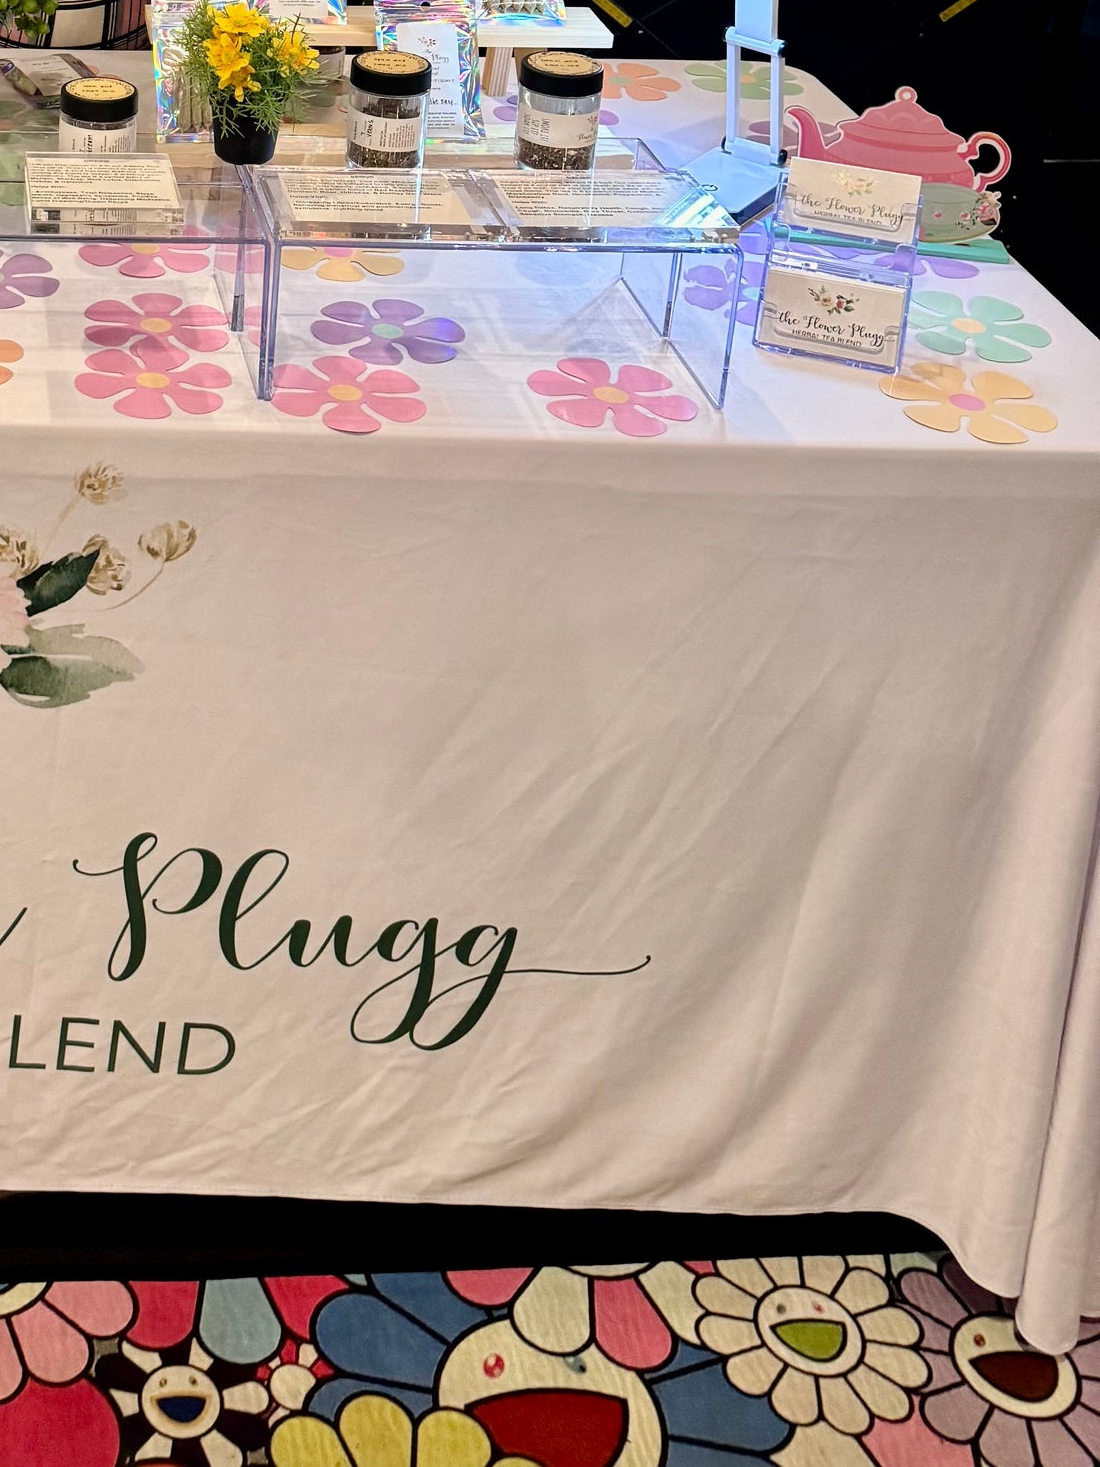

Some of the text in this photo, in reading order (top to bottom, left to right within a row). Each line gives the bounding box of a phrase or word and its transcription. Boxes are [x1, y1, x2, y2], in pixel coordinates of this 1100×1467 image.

[797, 192, 905, 225] the Flower Plugg
[777, 311, 885, 347] the Flower Plugg
[72, 832, 651, 1051] Plugg
